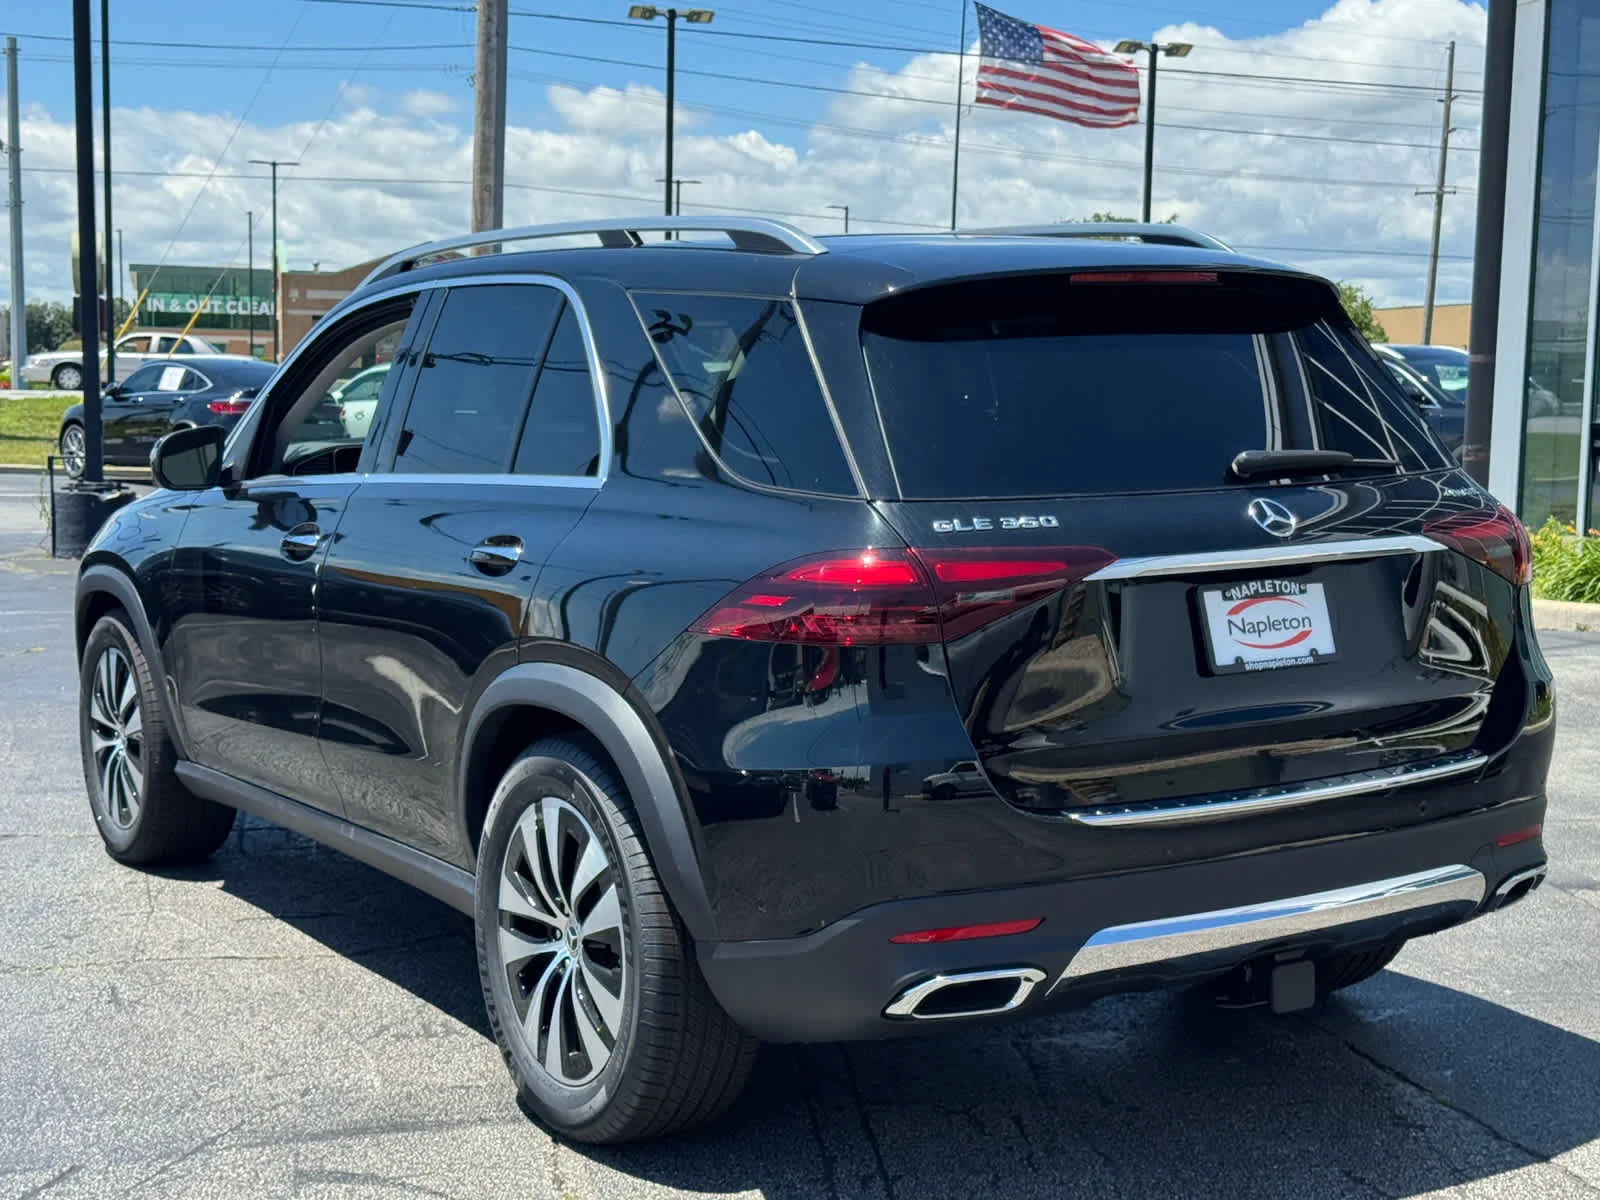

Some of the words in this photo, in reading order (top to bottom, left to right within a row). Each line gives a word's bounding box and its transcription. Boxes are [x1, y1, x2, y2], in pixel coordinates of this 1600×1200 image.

[146, 298, 165, 312] IN
[169, 298, 182, 312] &
[185, 299, 221, 313] OUT
[932, 517, 994, 533] GLE
[1000, 516, 1059, 529] 350
[1230, 580, 1300, 600] NAPLETON
[1227, 615, 1312, 638] Napleton
